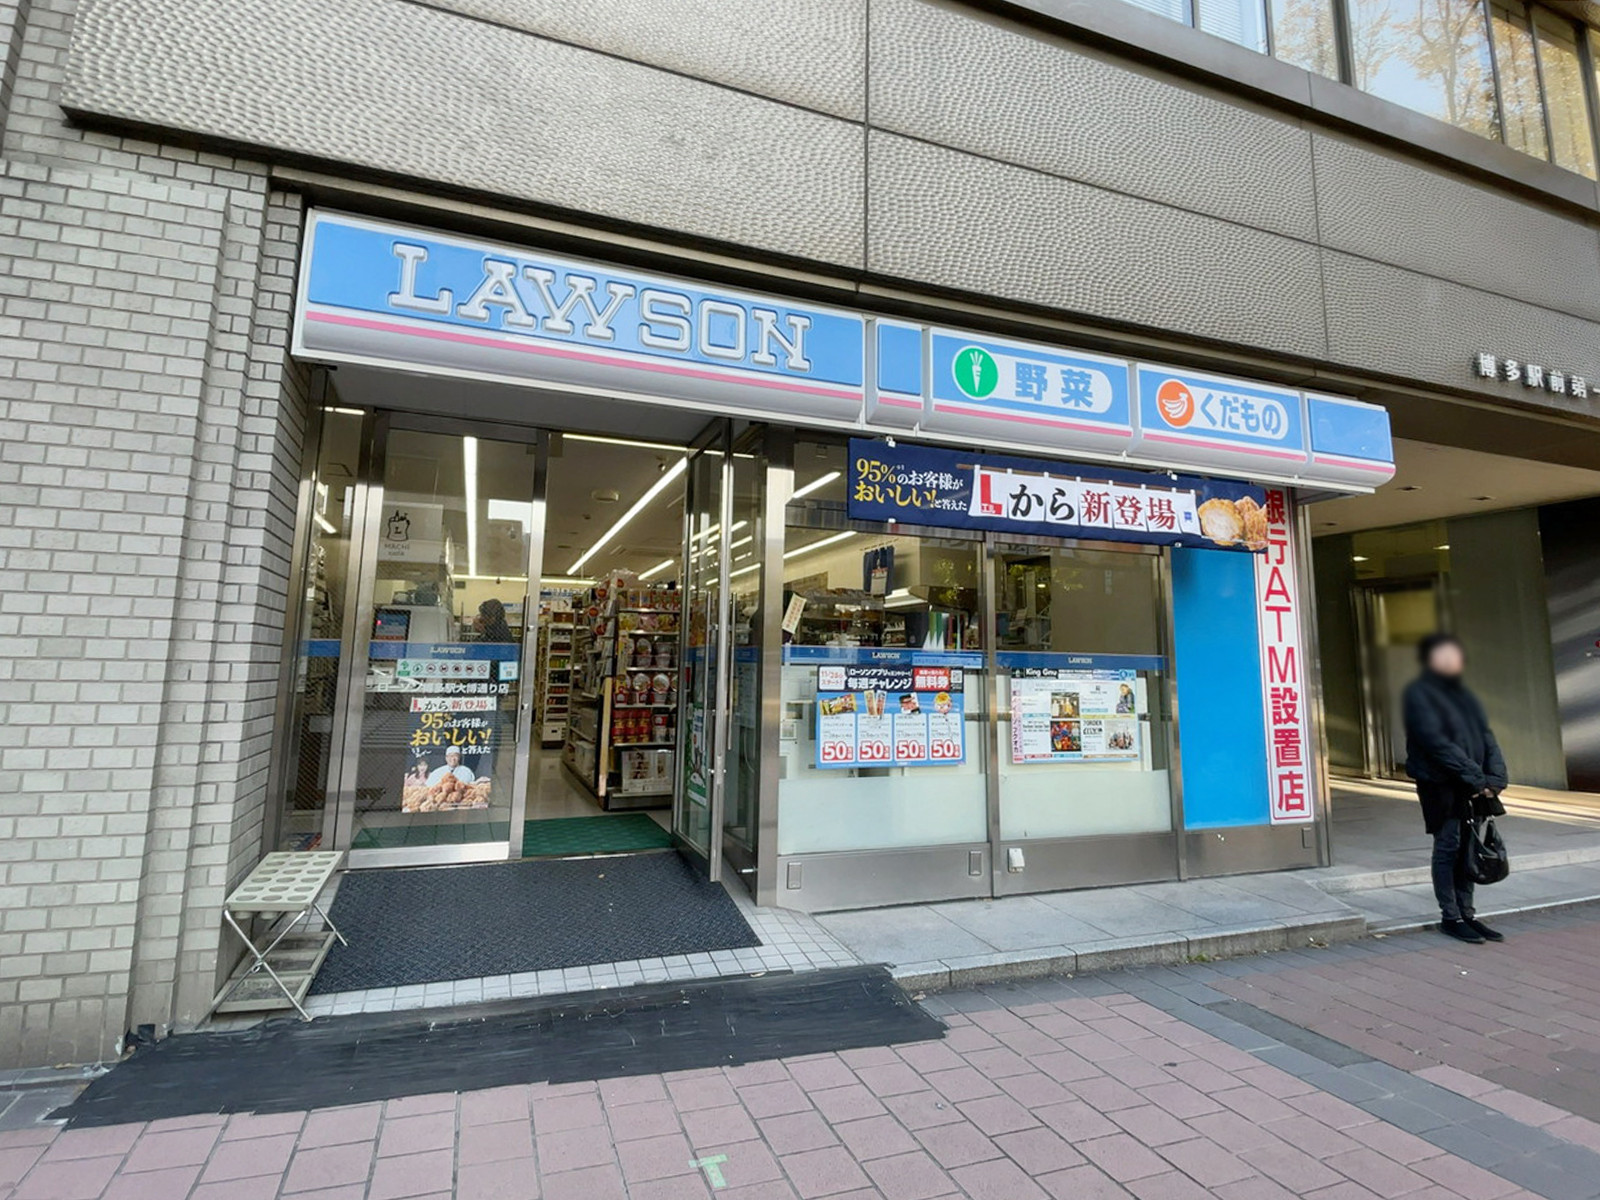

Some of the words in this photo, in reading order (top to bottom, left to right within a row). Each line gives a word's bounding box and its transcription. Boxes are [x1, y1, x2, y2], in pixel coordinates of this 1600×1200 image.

[387, 241, 813, 373] LAWSON
[1014, 360, 1094, 409] 野菜
[1199, 392, 1281, 436] くだもの
[848, 677, 912, 690] 毎週チャレンジ
[915, 676, 949, 689] 無料券
[410, 728, 492, 747] おいしい!
